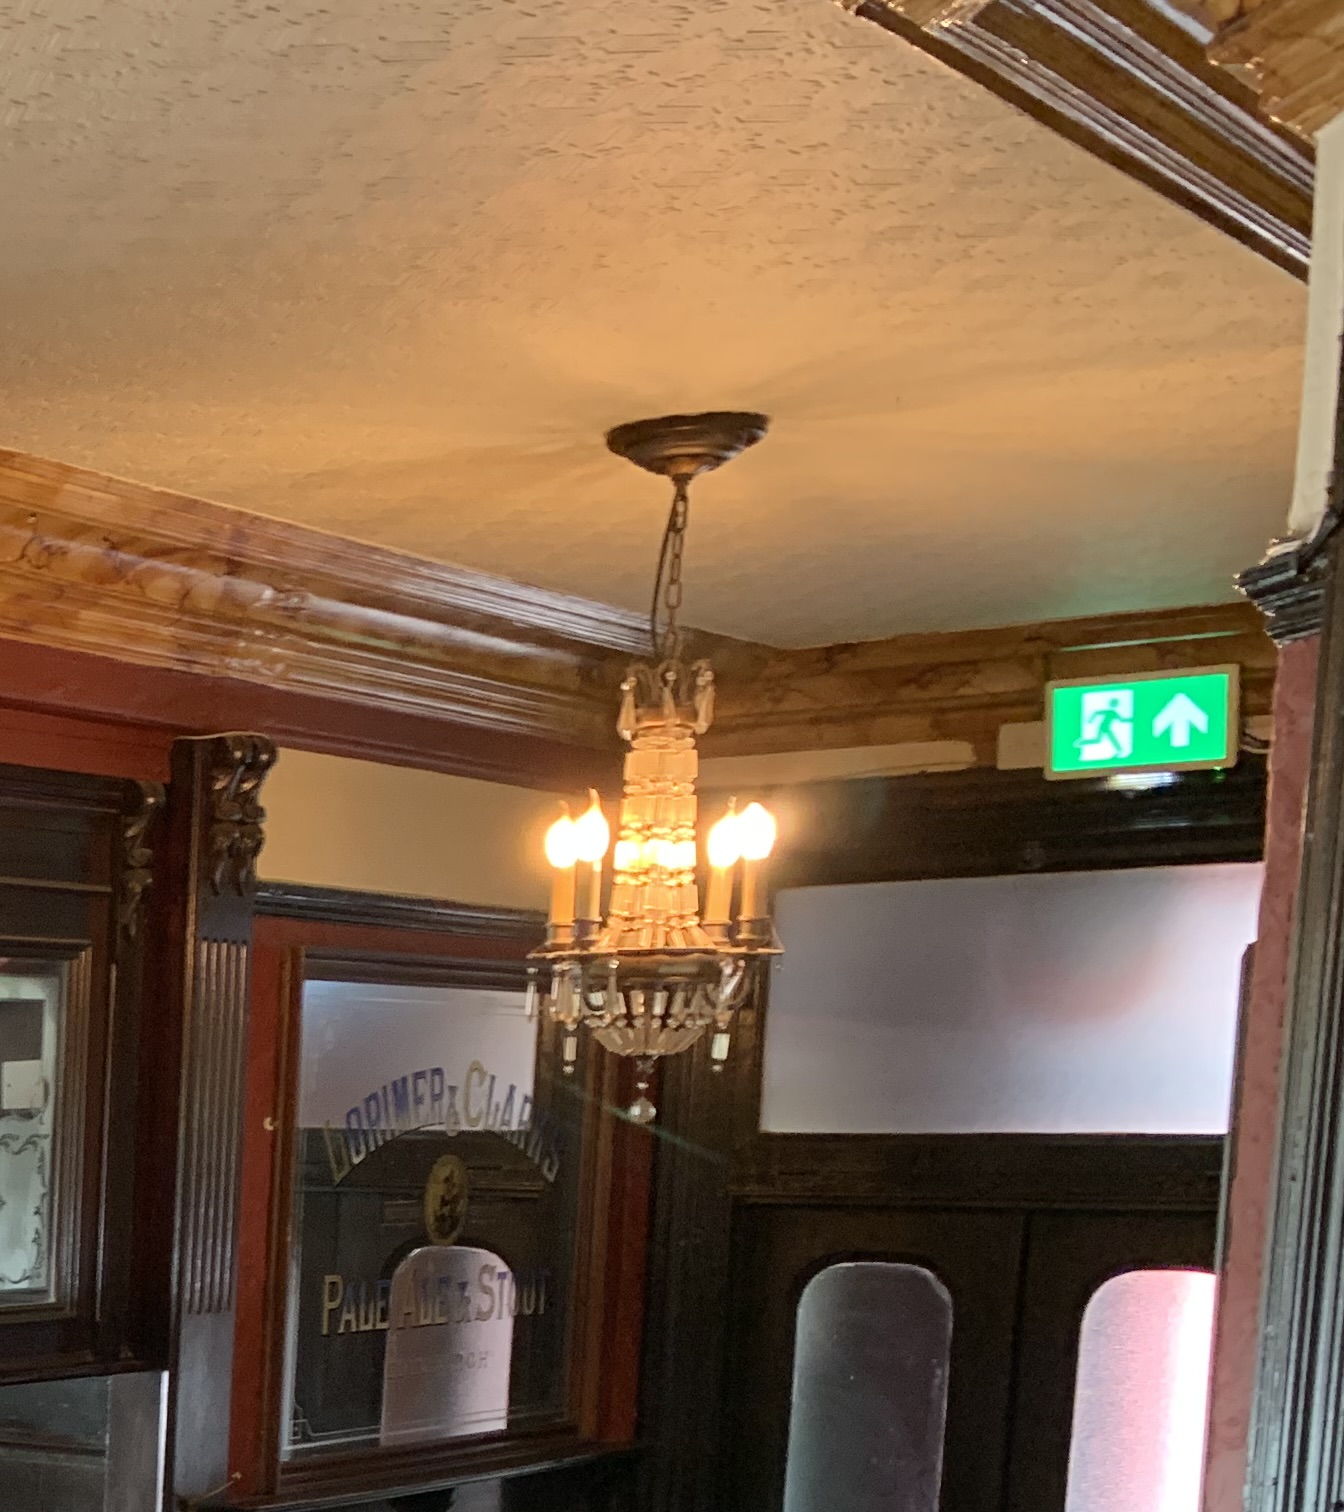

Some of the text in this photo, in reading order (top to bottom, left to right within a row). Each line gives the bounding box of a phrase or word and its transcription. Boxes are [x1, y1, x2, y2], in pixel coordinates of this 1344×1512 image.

[323, 1066, 446, 1187] LORIMER
[320, 1273, 390, 1336] PALE
[400, 1267, 449, 1329] ALE
[476, 1263, 549, 1322] STOUT
